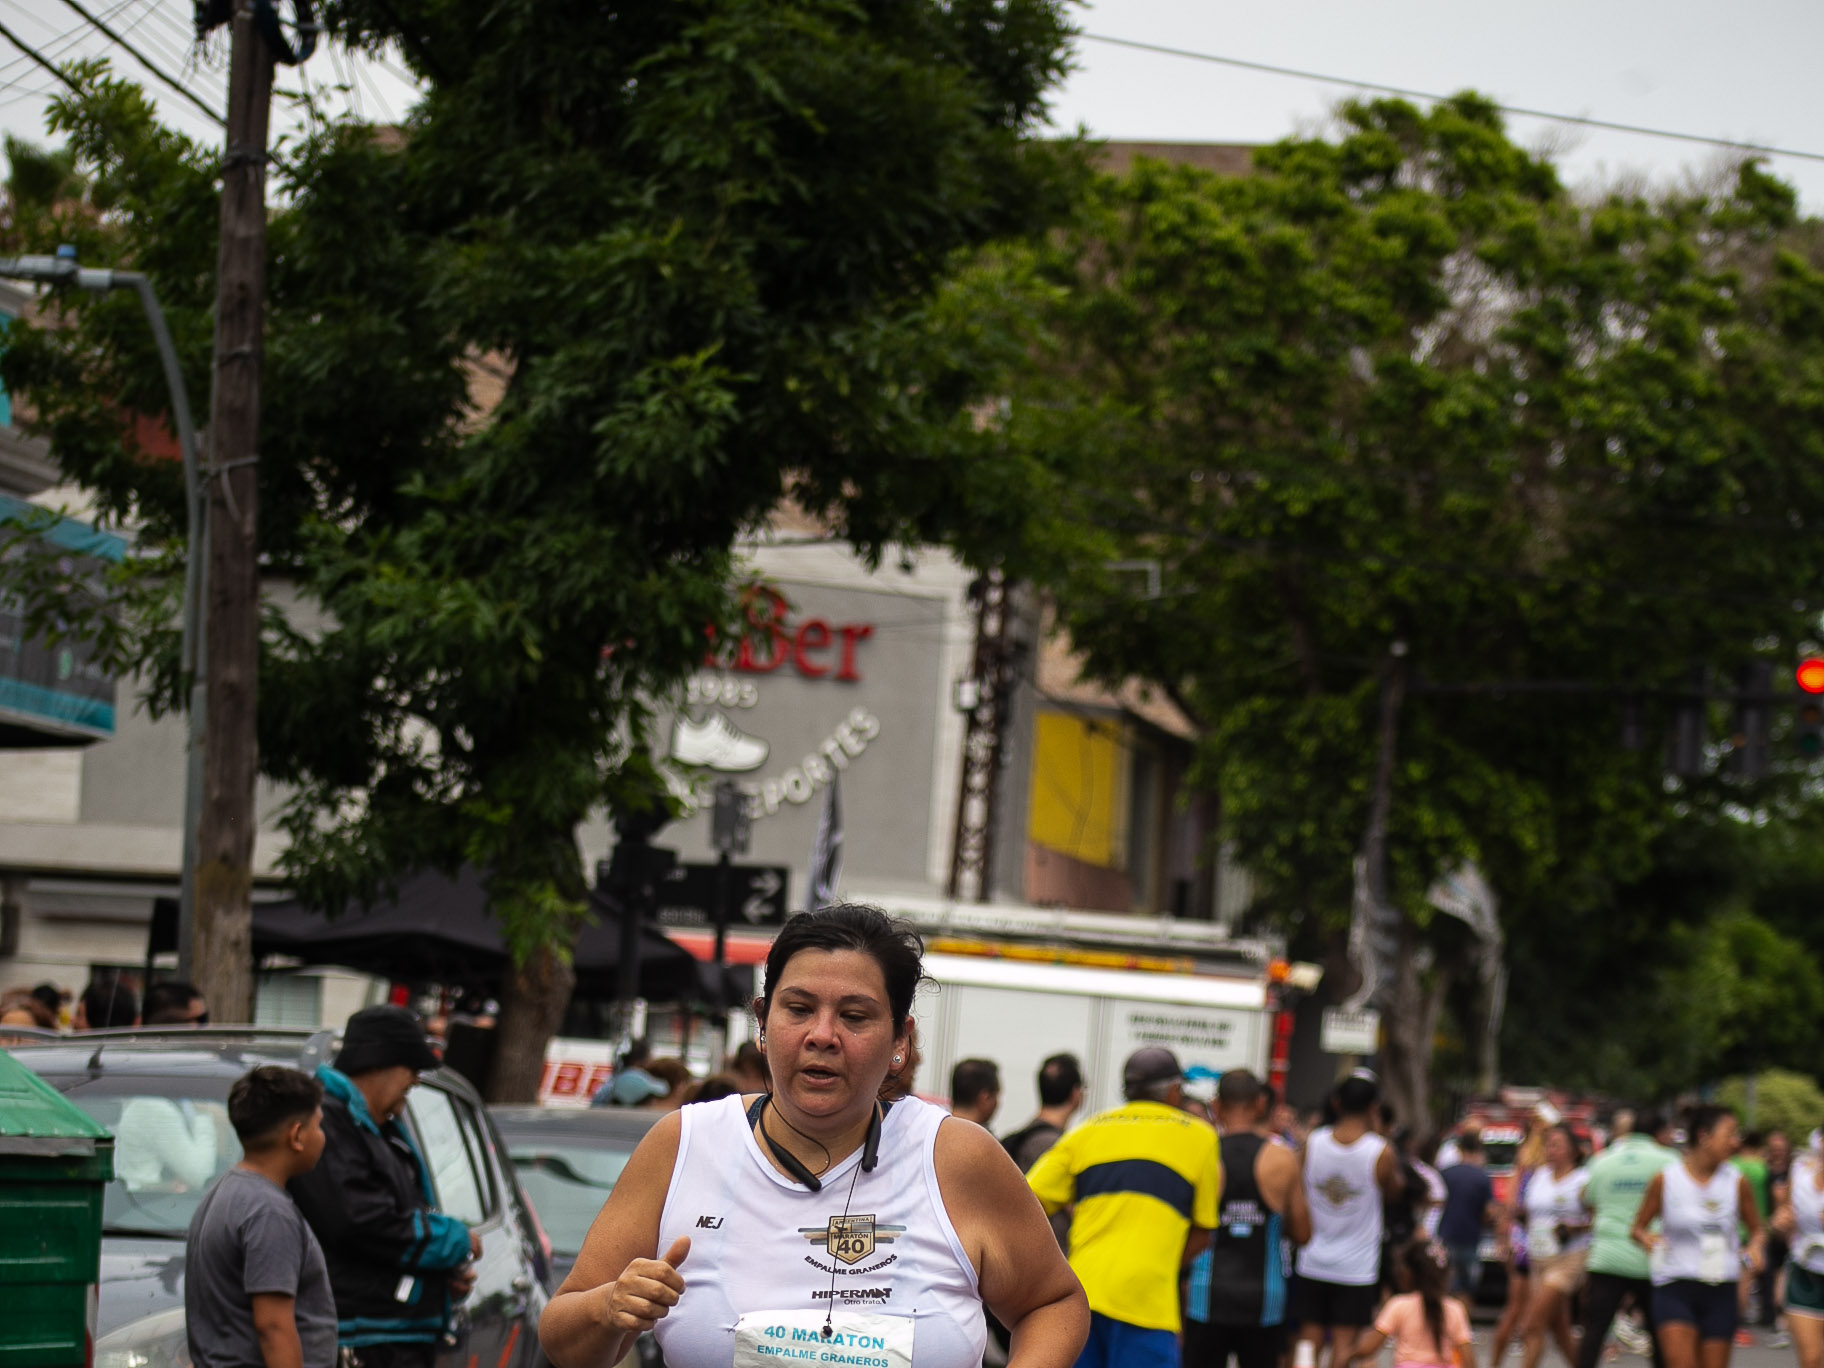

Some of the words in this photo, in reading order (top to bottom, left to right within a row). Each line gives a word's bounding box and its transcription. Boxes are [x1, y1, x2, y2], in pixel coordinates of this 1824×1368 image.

[695, 1215, 725, 1230] NEJ
[838, 1239, 865, 1254] 40
[804, 1255, 847, 1275] EMPALME
[848, 1253, 898, 1275] GRANEROS
[764, 1325, 786, 1339] 40
[757, 1345, 817, 1360] EMPALME
[820, 1352, 889, 1368] GRANEROS
